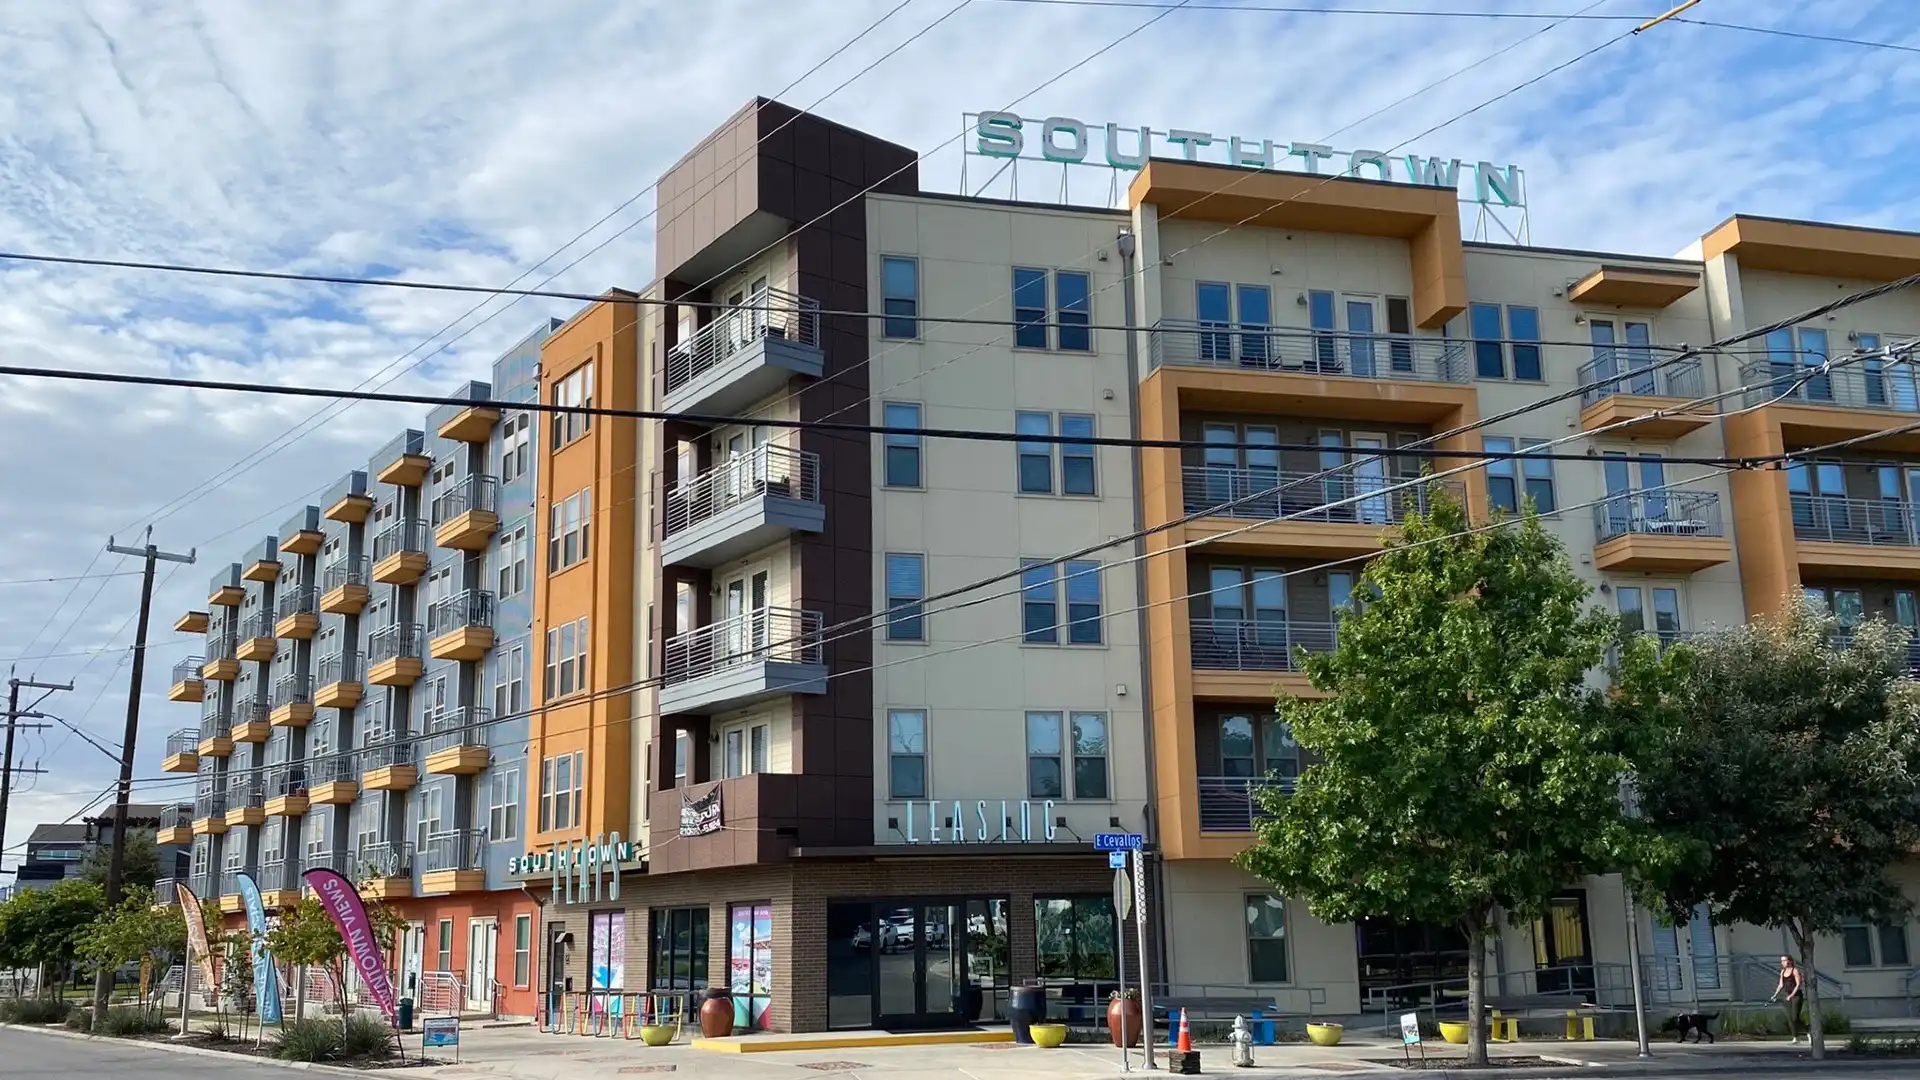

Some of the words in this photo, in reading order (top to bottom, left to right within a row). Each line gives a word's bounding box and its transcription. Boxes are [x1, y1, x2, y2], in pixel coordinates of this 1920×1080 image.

[977, 110, 1520, 207] SOUTHTOWN
[906, 799, 1057, 842] LEASING
[1096, 834, 1101, 847] E
[1103, 833, 1141, 848] Cevallos
[508, 841, 632, 873] SOUTHTOWN
[323, 878, 357, 928] VIEWS
[349, 928, 394, 1016] OWNTOWN
